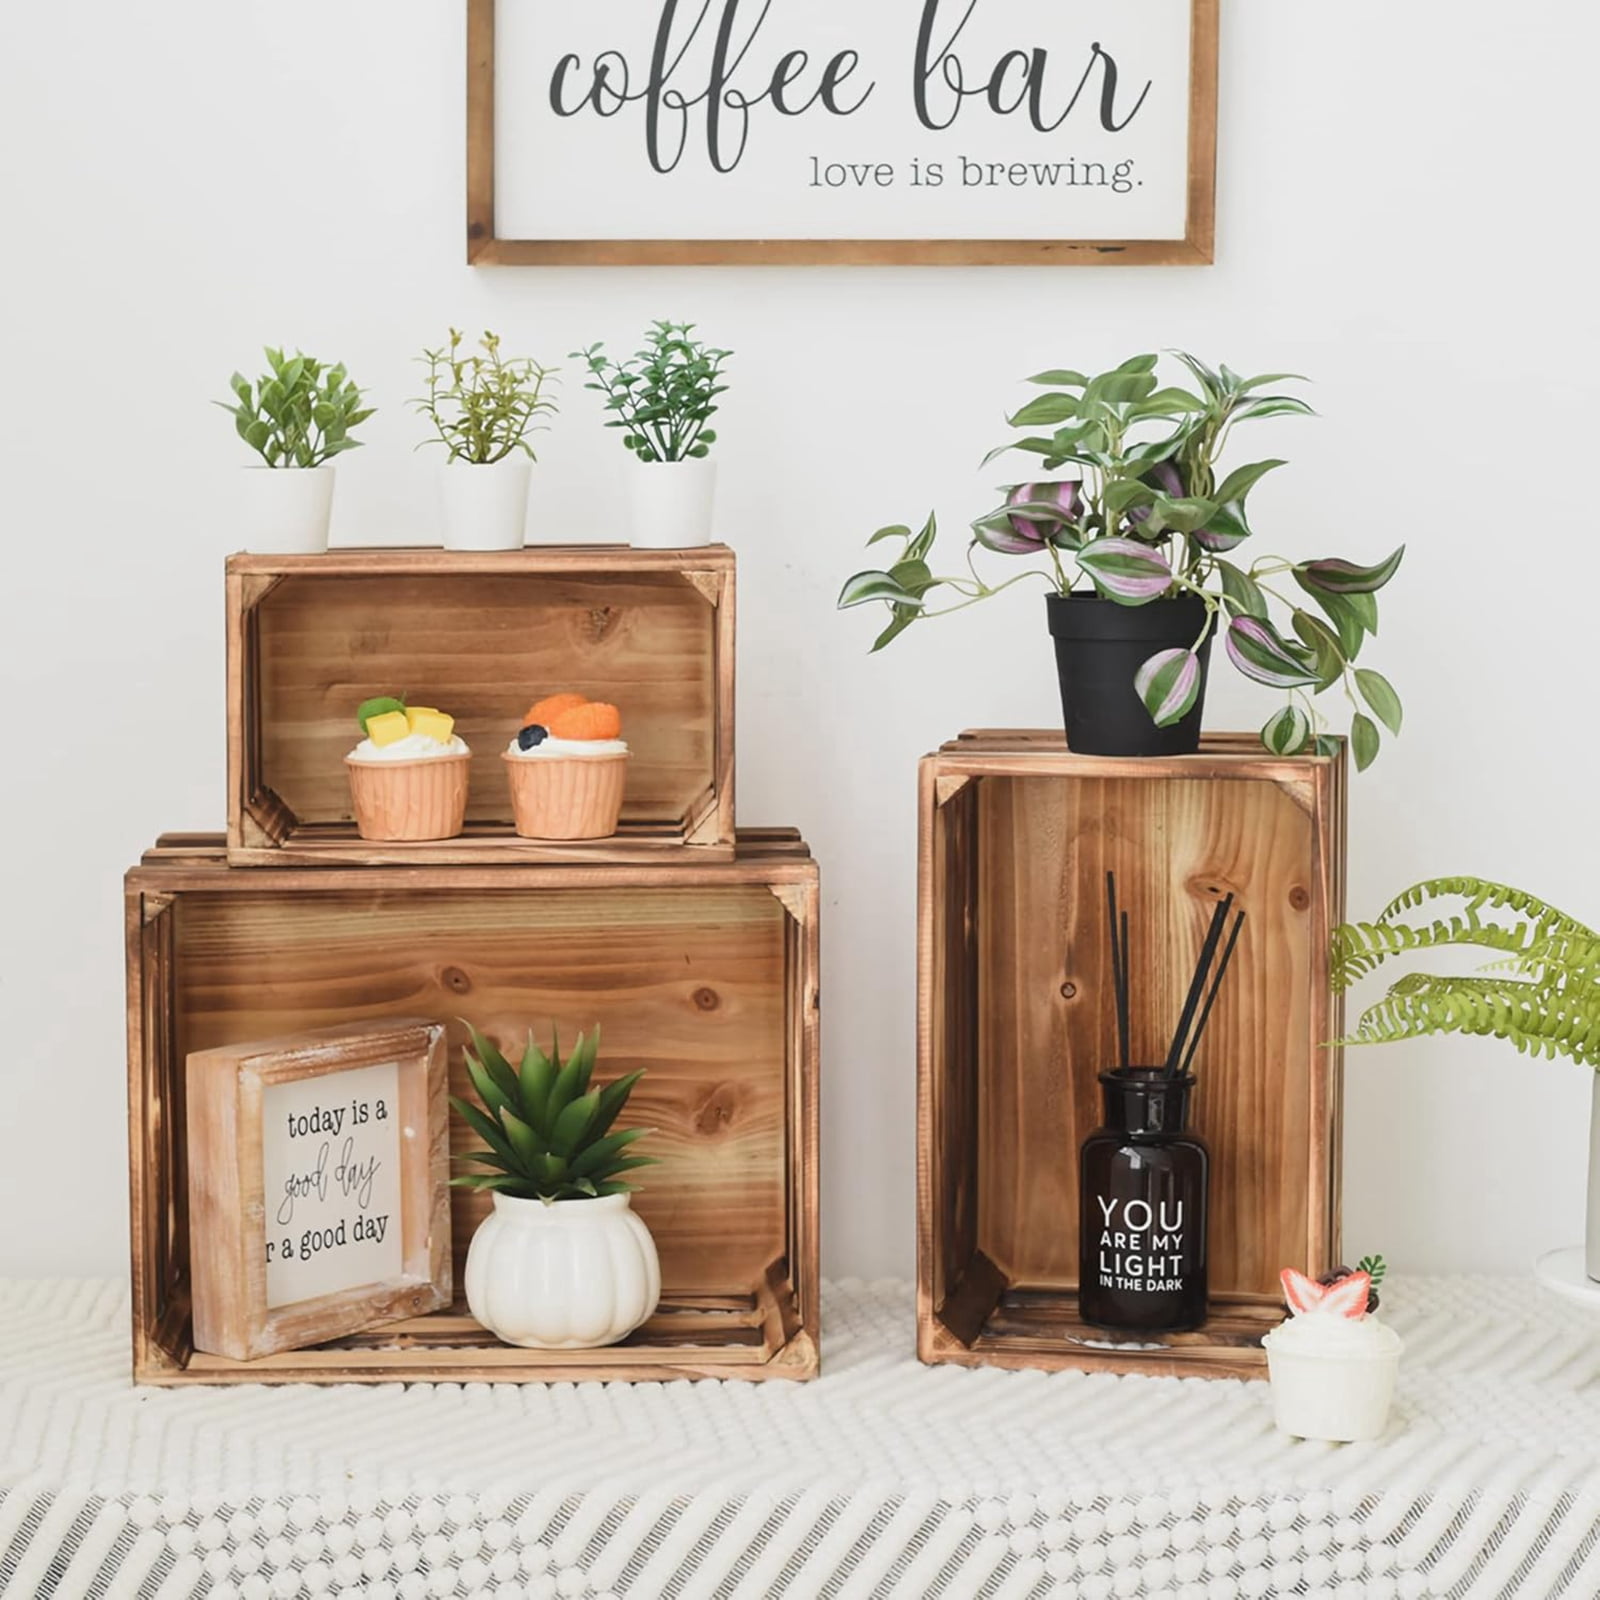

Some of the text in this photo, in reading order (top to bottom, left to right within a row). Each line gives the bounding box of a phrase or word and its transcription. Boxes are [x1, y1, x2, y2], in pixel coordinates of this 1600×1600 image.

[549, 0, 1153, 174] coffee bar
[809, 155, 1143, 193] love is brewing.
[287, 1099, 388, 1139] today is a
[277, 1136, 382, 1226] good day
[1097, 1194, 1184, 1233] YOU
[281, 1238, 294, 1260] a
[299, 1218, 347, 1261] good
[353, 1214, 389, 1244] day
[1100, 1229, 1184, 1251] ARE MY
[1099, 1274, 1184, 1292] IN THE DARK
[1100, 1250, 1184, 1277] LIGHT
